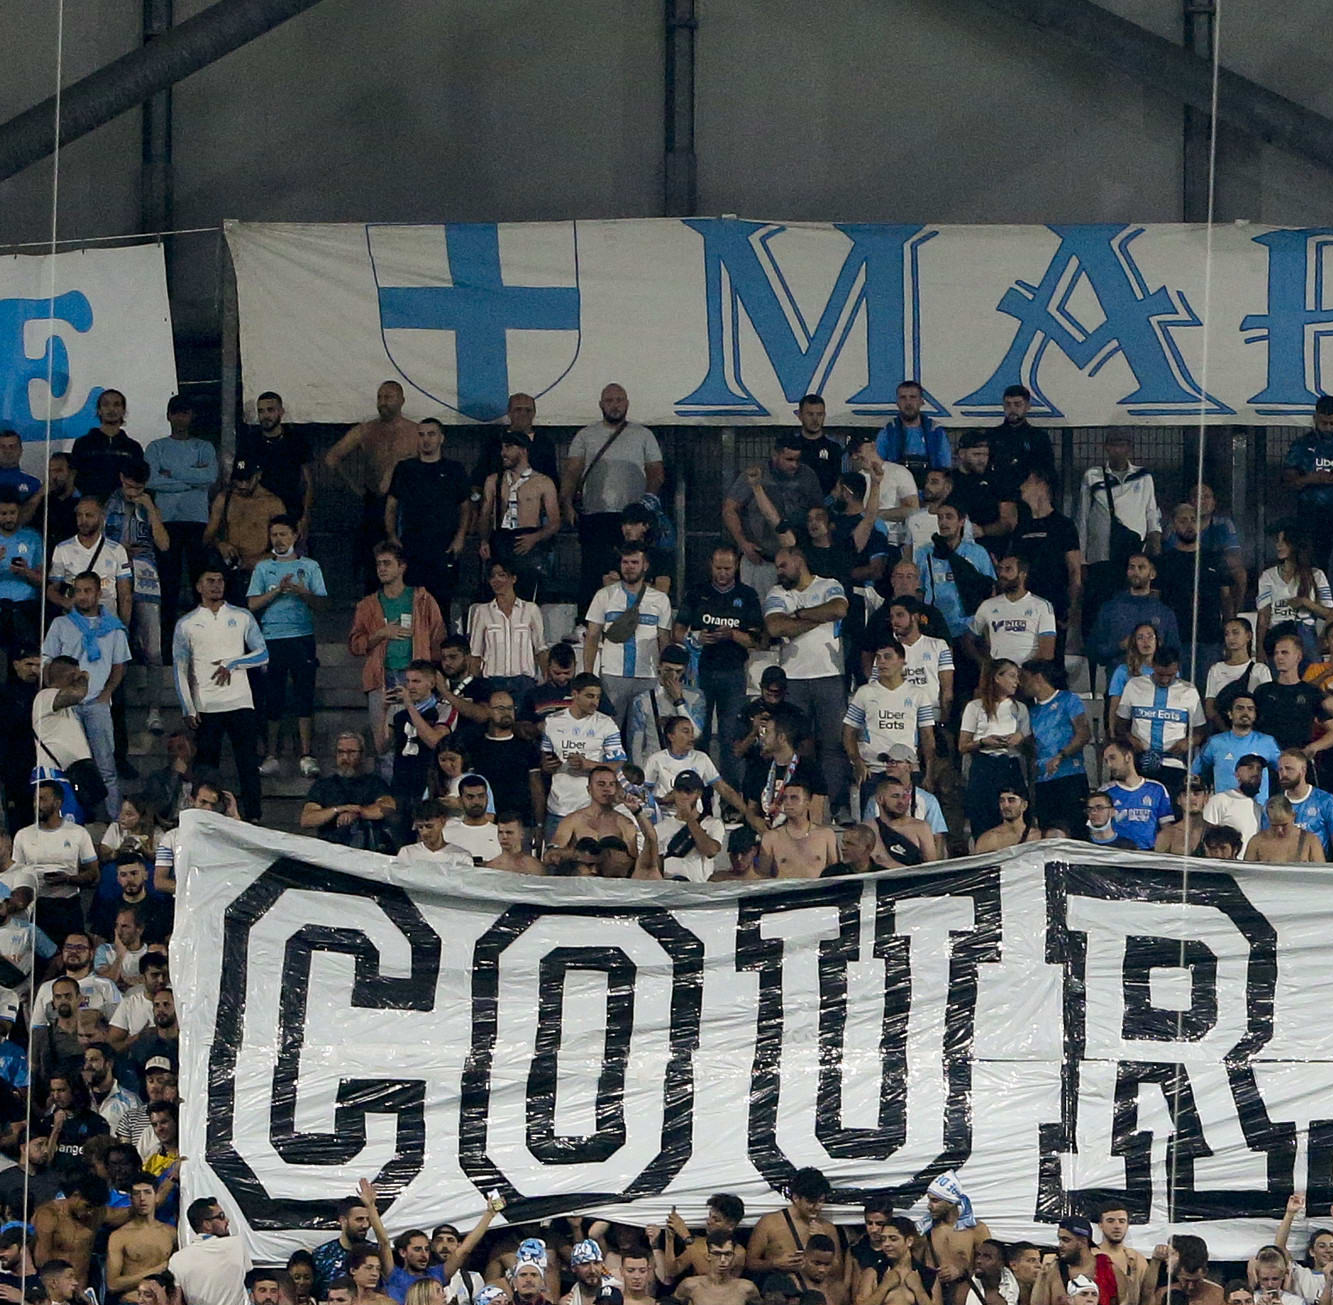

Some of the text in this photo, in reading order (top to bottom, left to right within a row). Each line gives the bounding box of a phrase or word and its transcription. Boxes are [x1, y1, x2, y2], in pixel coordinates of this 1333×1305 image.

[703, 613, 741, 629] Orange
[879, 709, 905, 719] Uber
[879, 720, 905, 730] Eats
[562, 740, 586, 750] Uber
